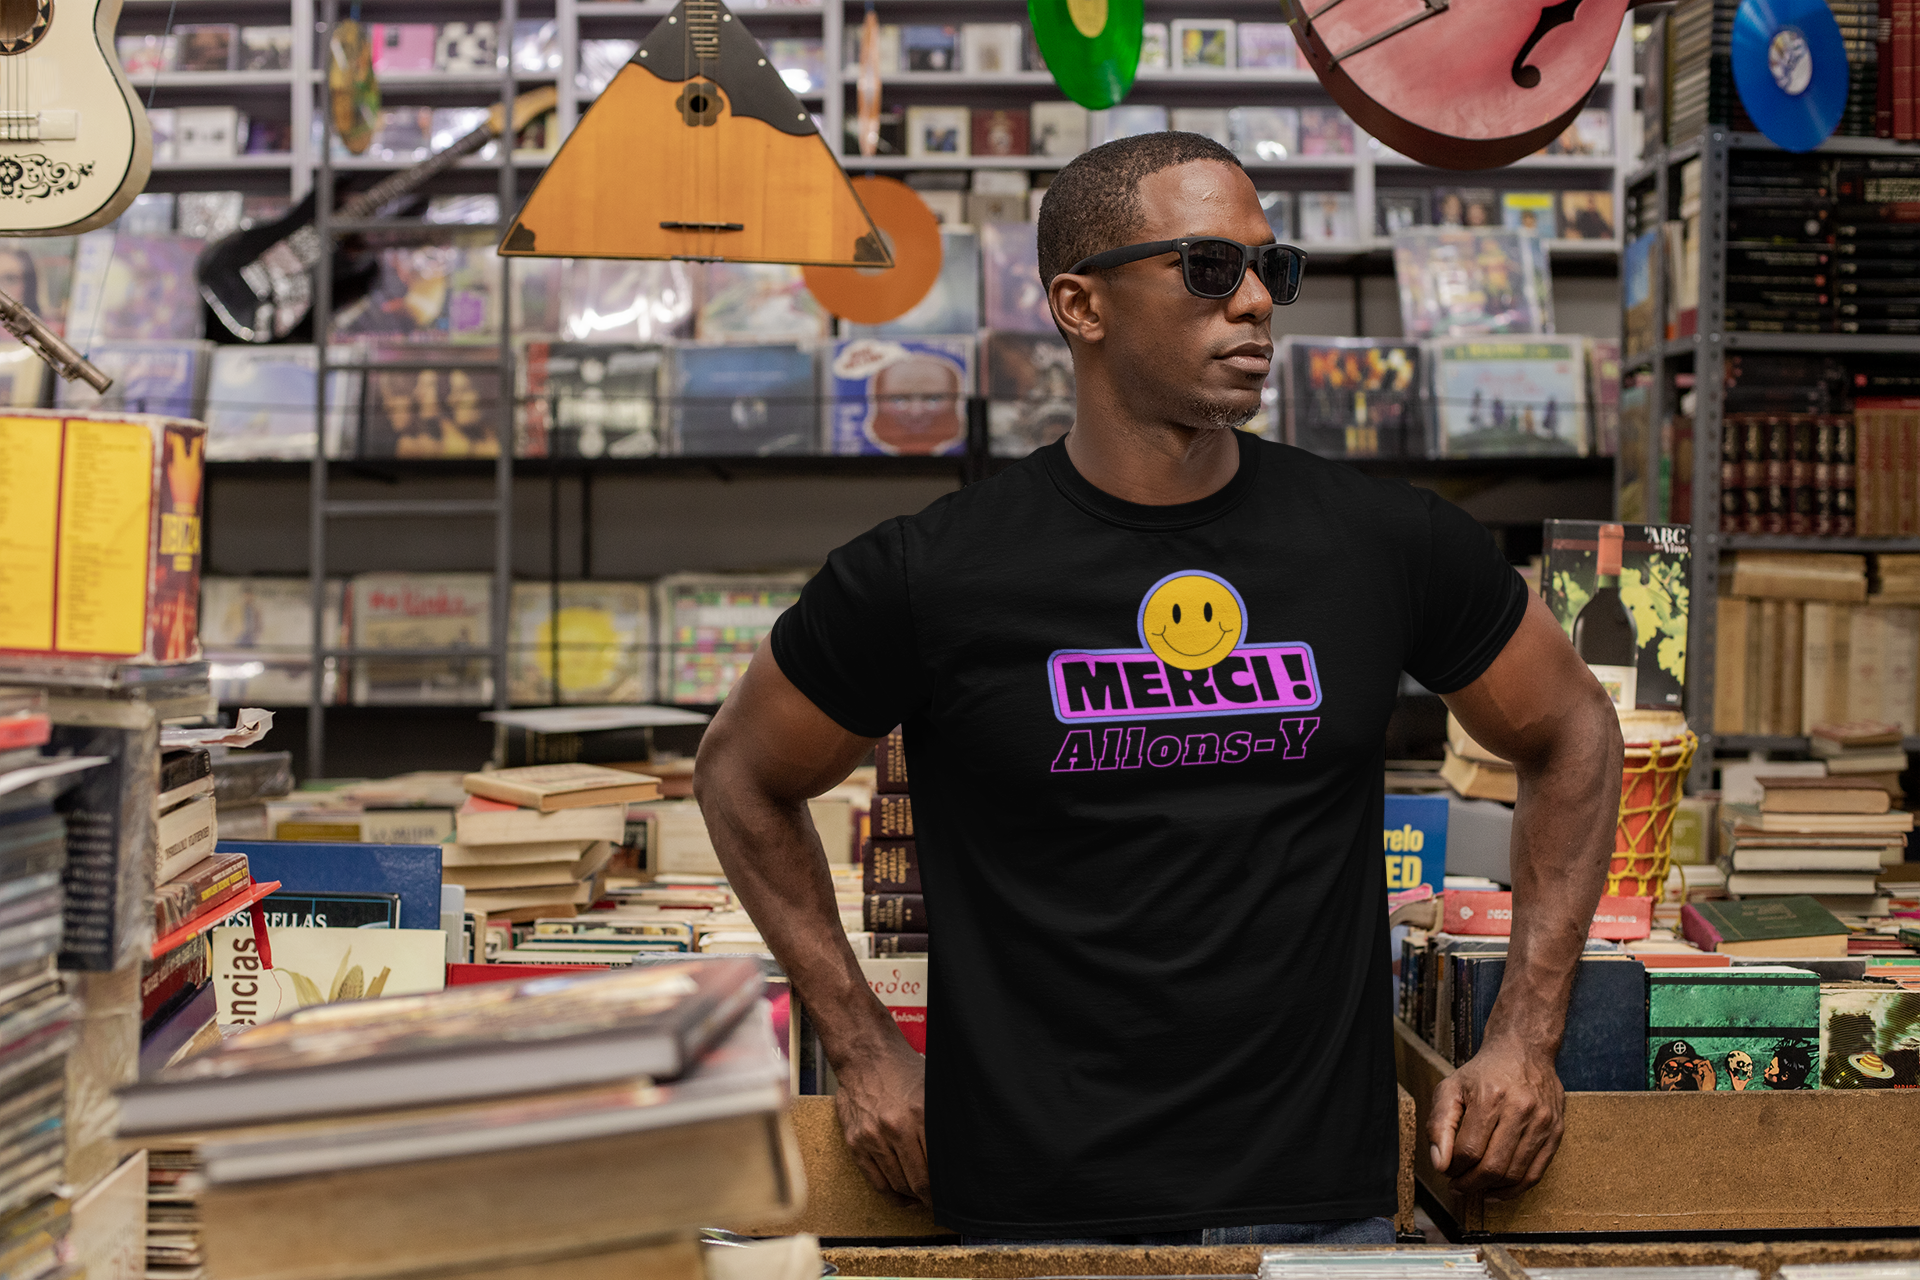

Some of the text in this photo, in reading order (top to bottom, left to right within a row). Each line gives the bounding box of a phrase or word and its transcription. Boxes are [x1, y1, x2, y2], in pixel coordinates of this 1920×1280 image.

[1050, 716, 1321, 772] Allons-Y
[881, 797, 889, 834] AMADO
[874, 847, 882, 883] AMADO
[223, 937, 259, 1026] ncias
